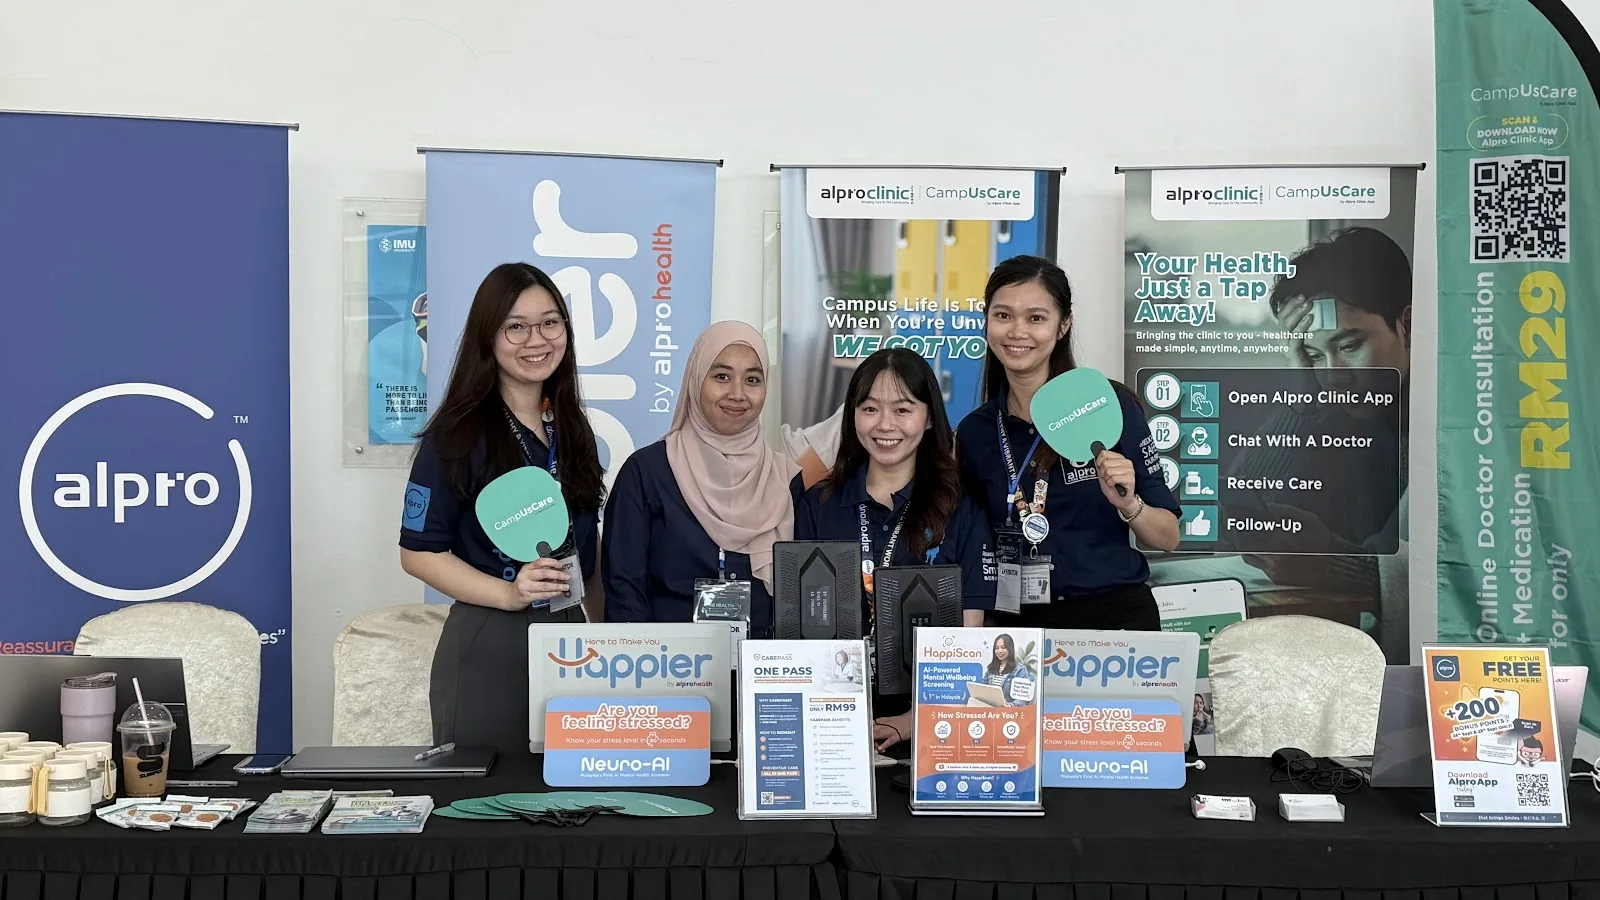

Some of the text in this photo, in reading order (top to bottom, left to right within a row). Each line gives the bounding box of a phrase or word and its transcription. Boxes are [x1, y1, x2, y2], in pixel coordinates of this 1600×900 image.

[1471, 84, 1577, 101] CampUsCare
[1502, 116, 1530, 125] SCAN
[1477, 126, 1558, 138] DOWNLOAD NOW
[1482, 135, 1554, 147] Alpro Clinic App
[821, 185, 910, 203] alproclinic
[926, 187, 1021, 200] CampUsCare
[1166, 186, 1258, 205] alproclinic
[1275, 186, 1376, 200] CampUsCare
[393, 240, 416, 249] IMU
[1134, 251, 1297, 278] Your Health,
[1135, 276, 1268, 301] Just a Tap
[822, 297, 897, 314] Campus
[904, 297, 939, 312] Life
[945, 298, 960, 312] Is
[1134, 300, 1216, 325] Away!
[650, 223, 678, 413] by alprohealth
[826, 314, 945, 330] When You're
[1136, 331, 1176, 342] Bringing
[1178, 331, 1195, 340] the
[1196, 331, 1222, 340] clinic
[1224, 332, 1233, 340] to
[1236, 333, 1254, 342] you
[1263, 331, 1314, 340] healthcare
[833, 334, 883, 359] WE
[883, 335, 945, 359] GOT
[1136, 344, 1289, 355] made simple, anytime, anywhere
[1518, 270, 1571, 470] RM29
[1156, 386, 1171, 401] 01
[1228, 390, 1393, 406] Open Alpro Clinic App
[233, 415, 249, 424] TM
[1048, 396, 1108, 432] CampUsCare
[1155, 428, 1170, 442] 02
[1228, 435, 1373, 447] Chat With A Doctor
[1471, 272, 1498, 645] Online Doctor Consultation
[1067, 467, 1096, 480] alpro
[1227, 478, 1322, 490] Receive Care
[53, 461, 220, 523] alpro
[493, 496, 554, 531] CampUsCare
[1227, 519, 1302, 533] Follow-Up
[1509, 473, 1533, 625] Medication
[1546, 543, 1573, 648] for only
[0, 640, 74, 654] eassura
[923, 647, 982, 660] HappiScan
[549, 638, 713, 688] Happier
[1483, 662, 1542, 677] FREE
[754, 667, 812, 675] ONE PASS
[946, 674, 977, 682] Wellbeing
[923, 681, 955, 689] Screening
[596, 704, 657, 719] Are you
[1072, 705, 1132, 720] Are you
[1447, 697, 1500, 720] +200
[562, 715, 692, 730] feeling stressed?
[1094, 718, 1166, 733] stressed?
[1454, 718, 1505, 732] BONUS POINTS
[581, 757, 670, 771] Neuro-AI
[1060, 758, 1147, 773] Neuro-AI
